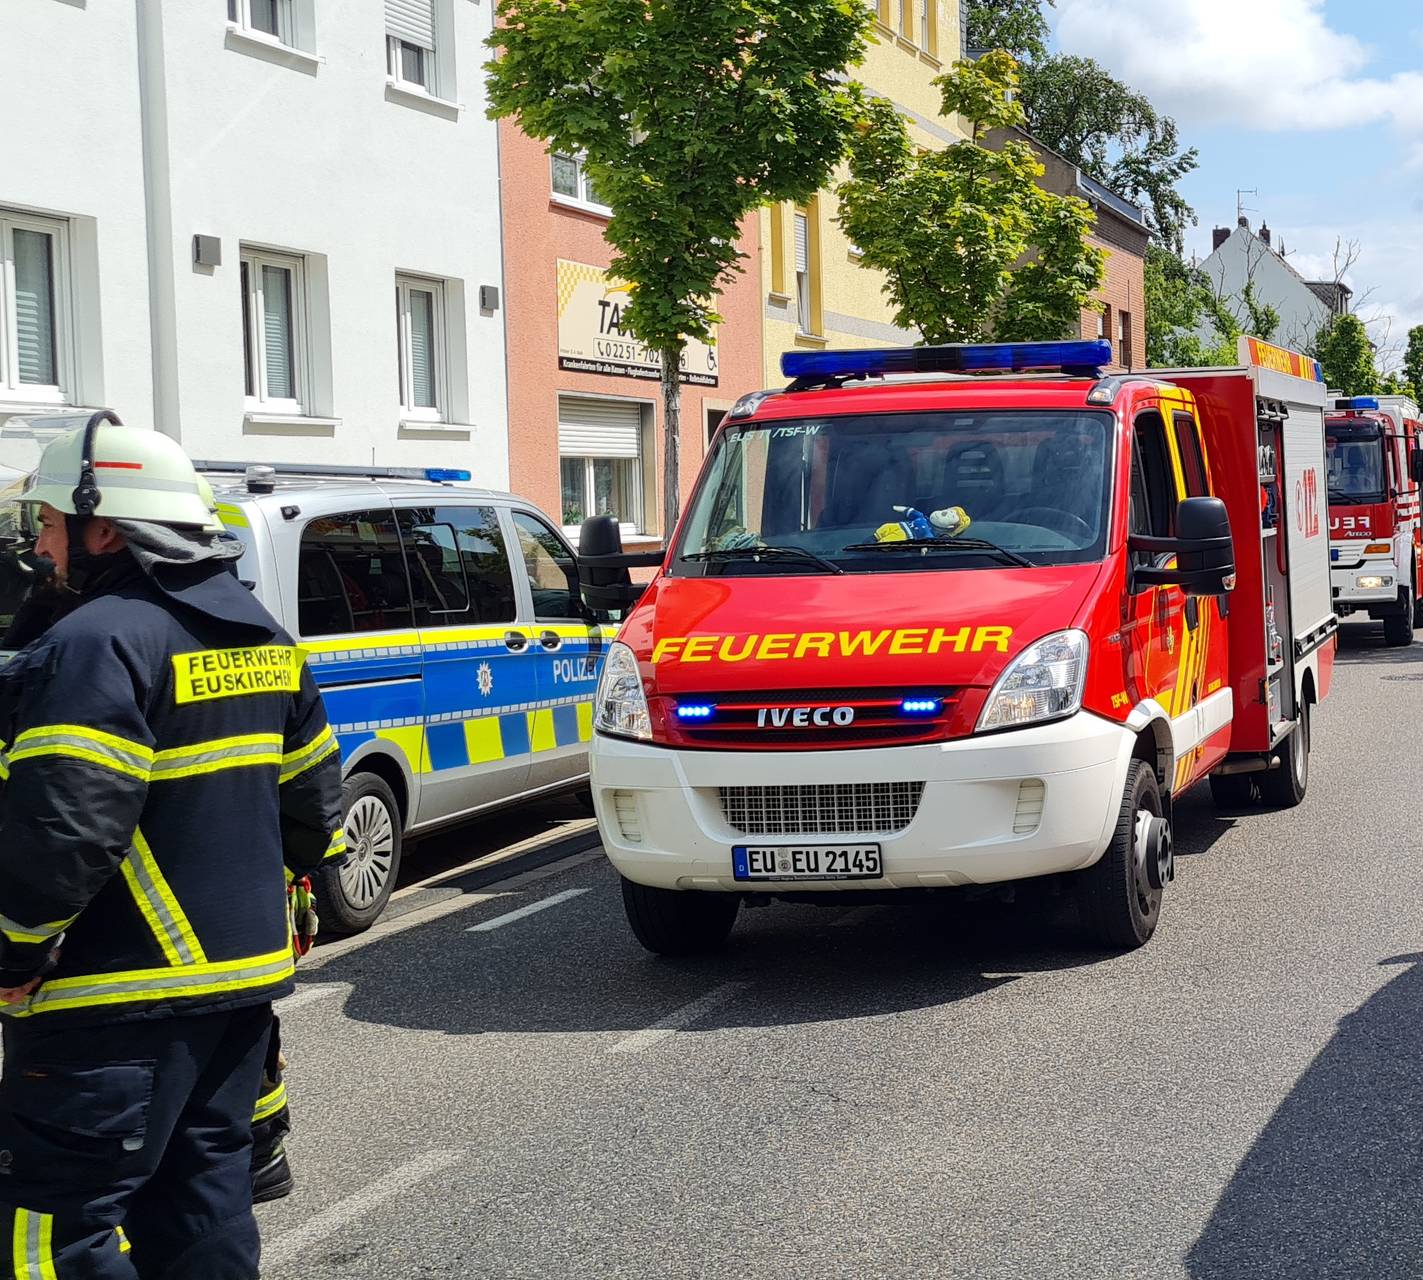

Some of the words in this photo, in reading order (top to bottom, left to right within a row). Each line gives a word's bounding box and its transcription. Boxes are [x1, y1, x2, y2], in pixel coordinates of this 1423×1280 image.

[650, 626, 1013, 664] FEUERWEHR
[188, 649, 292, 674] FEUERWEHR
[190, 671, 292, 696] EUSKIRCHEN
[757, 707, 855, 728] IVECO
[749, 850, 777, 873] EU
[792, 850, 820, 873] EU
[825, 850, 879, 873] 2145
